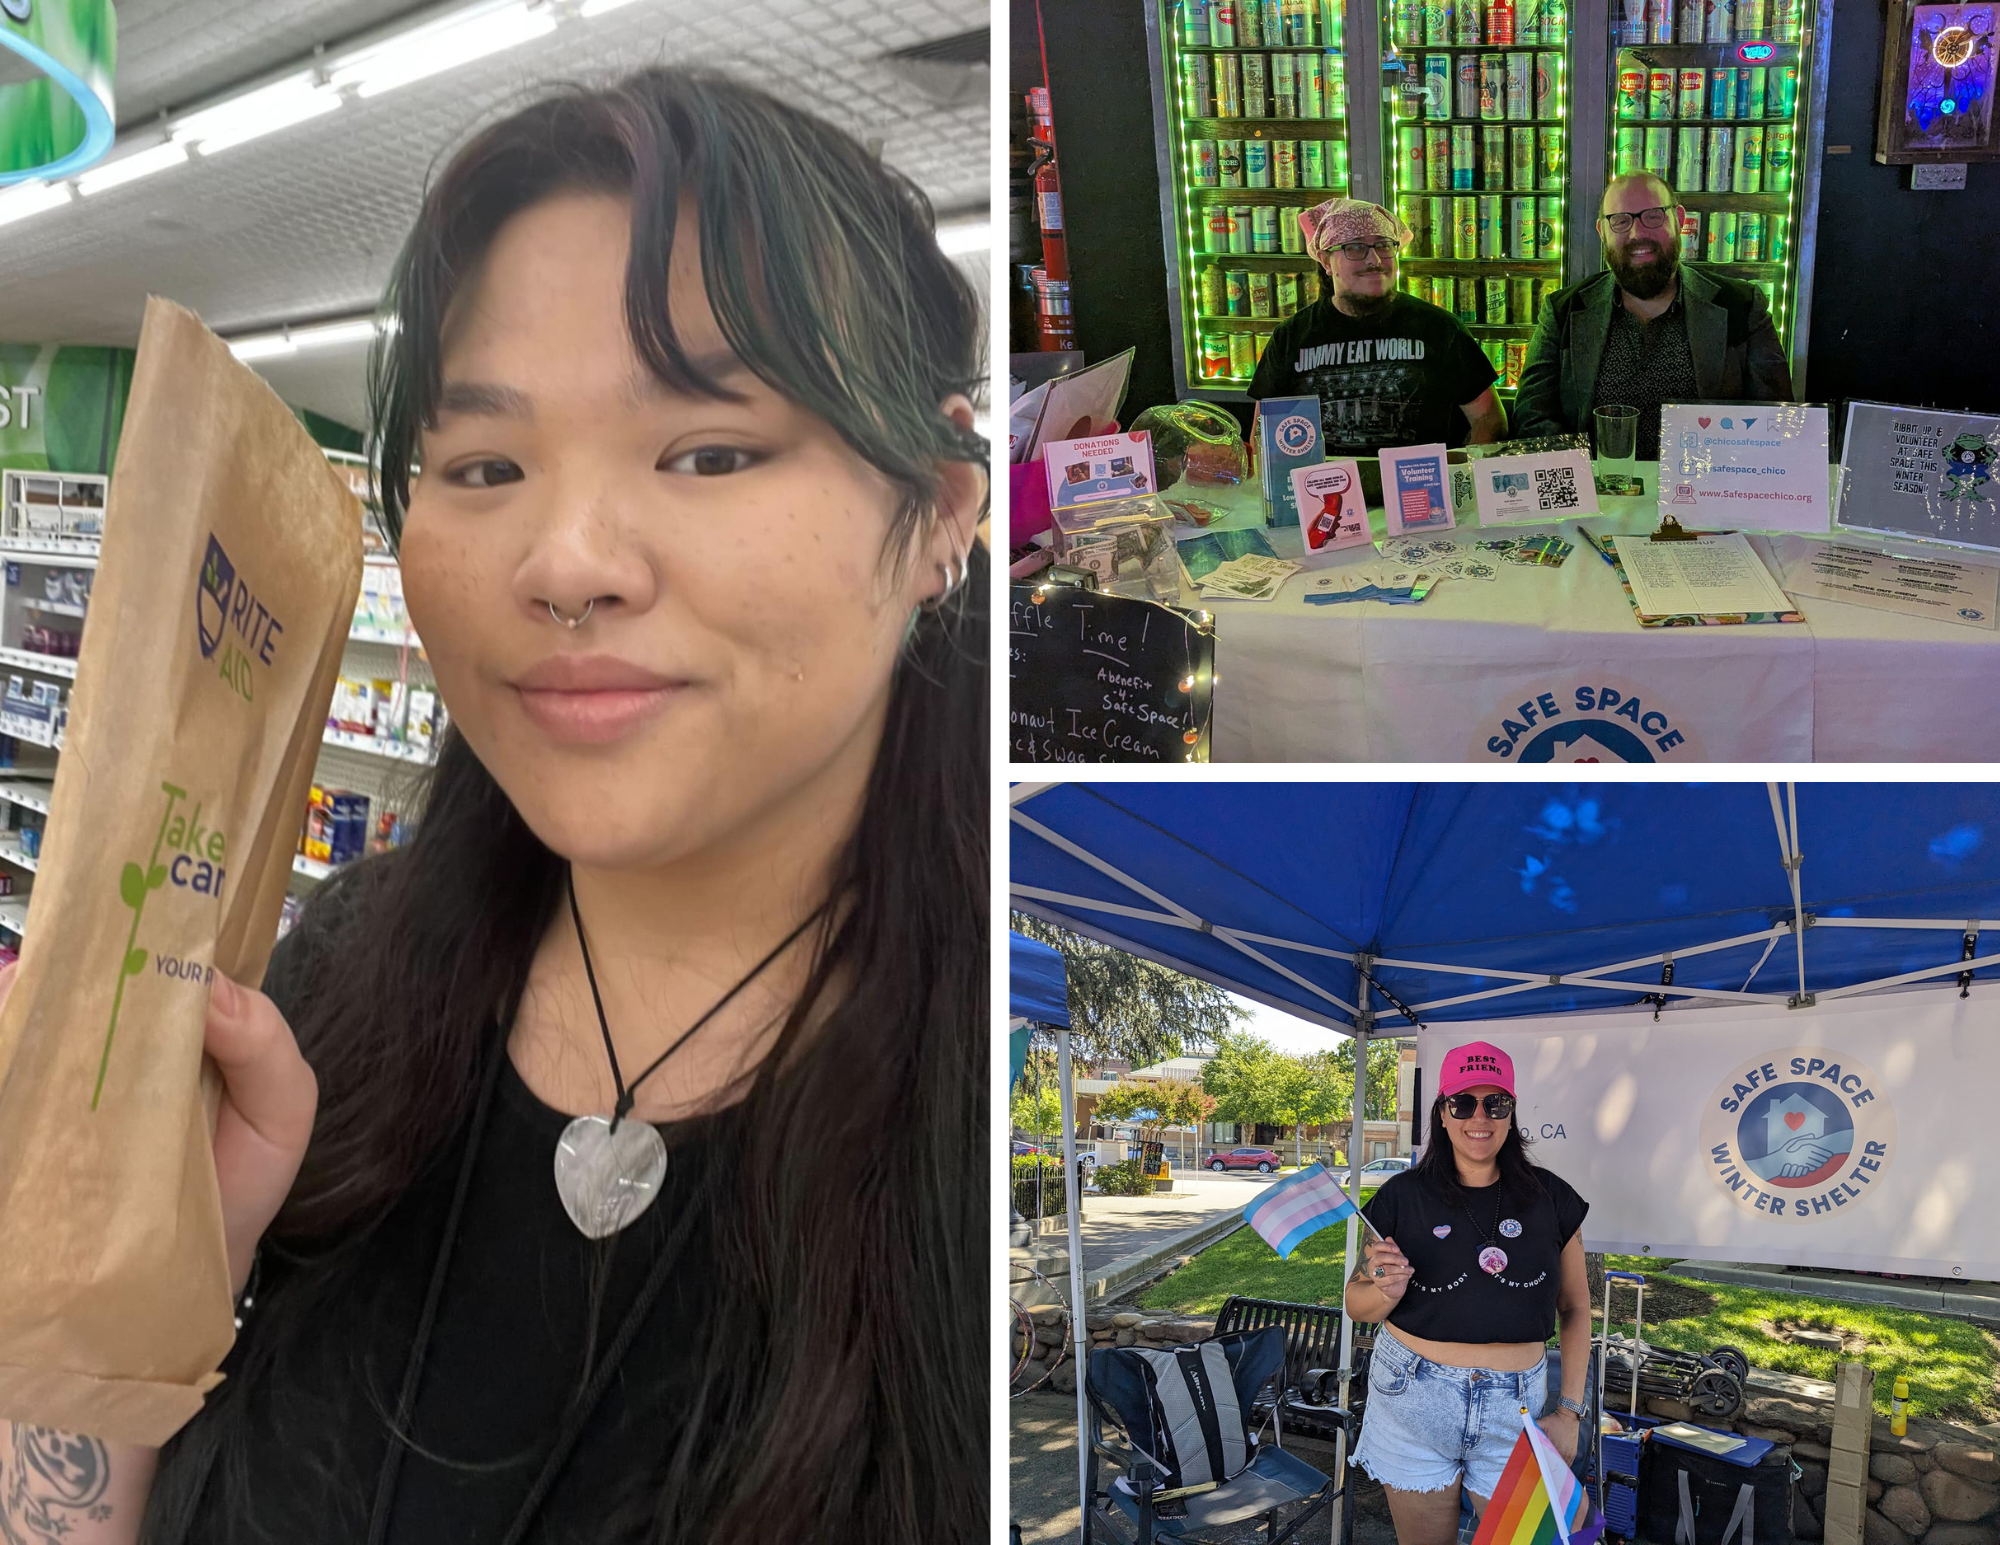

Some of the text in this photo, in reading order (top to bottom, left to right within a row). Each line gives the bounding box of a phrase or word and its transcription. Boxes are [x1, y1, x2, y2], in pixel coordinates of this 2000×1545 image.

[1295, 338, 1425, 373] JIMMY EAT WORLD
[1279, 417, 1312, 432] SAFE SPACE
[1893, 422, 1919, 433] RIBBIT
[1922, 425, 1932, 435] UP
[1073, 438, 1120, 451] DONATIONS
[1278, 435, 1315, 454] WINTER SHELTER
[1704, 437, 1782, 447] @chicosafespace
[1896, 434, 1938, 448] VOLUNTEER
[1082, 447, 1114, 458] NEEDED
[1897, 447, 1934, 459] AT SAFE
[1401, 467, 1436, 476] Volunteer
[1890, 457, 1938, 472] SPACE THIS
[1404, 474, 1434, 483] Training
[1895, 470, 1924, 482] WINTER
[1699, 489, 1813, 503] www.Safespacechico.org
[1677, 539, 1716, 547] SIGNUP
[231, 577, 283, 667] RITE
[219, 642, 254, 703] AID
[1102, 694, 1135, 714] Safe
[1487, 686, 1685, 758] SAFE SPACE
[1066, 708, 1098, 740] Ice
[1103, 719, 1160, 759] Cream
[161, 780, 226, 864] Take
[155, 953, 204, 984] YOUR
[1467, 1055, 1497, 1064] BEST
[1459, 1064, 1502, 1076] FRIEND
[1720, 1057, 1875, 1113] SAFE SPACE
[1541, 1123, 1567, 1139] CA
[1711, 1140, 1887, 1217] WINTER SHELTER
[1412, 1280, 1426, 1291] IT'S
[1447, 1272, 1468, 1290] BODY
[1523, 1271, 1547, 1288] CHOICE
